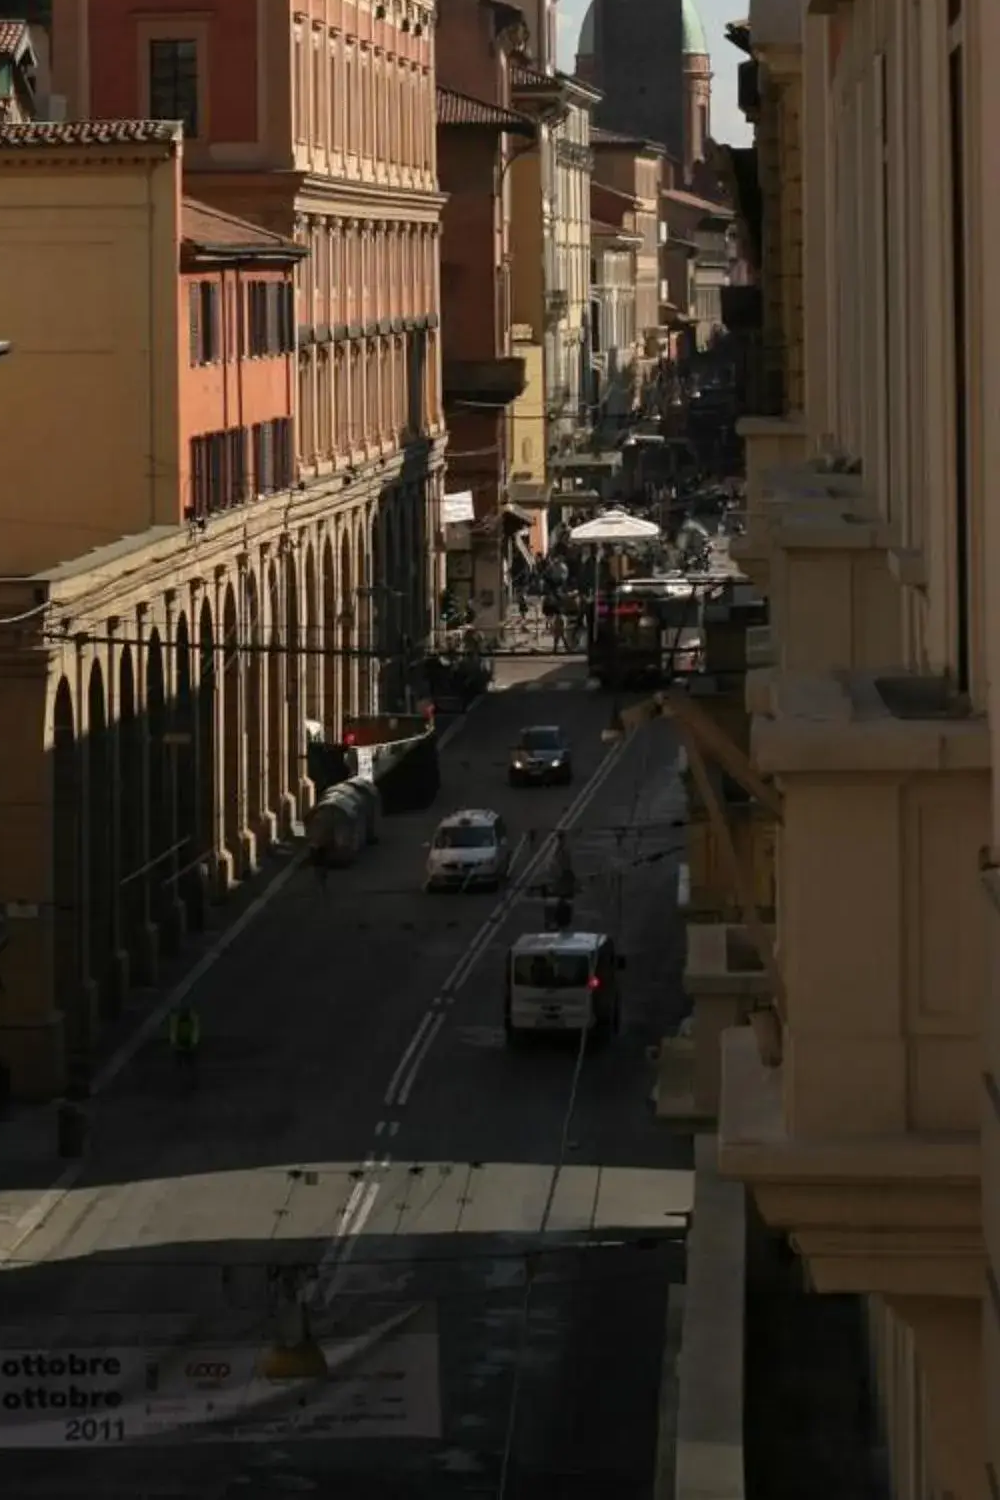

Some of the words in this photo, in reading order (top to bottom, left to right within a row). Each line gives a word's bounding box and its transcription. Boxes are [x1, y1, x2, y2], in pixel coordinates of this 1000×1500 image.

[1, 1353, 121, 1376] ottobre
[2, 1384, 123, 1410] ottobre
[65, 1418, 125, 1441] 2011
